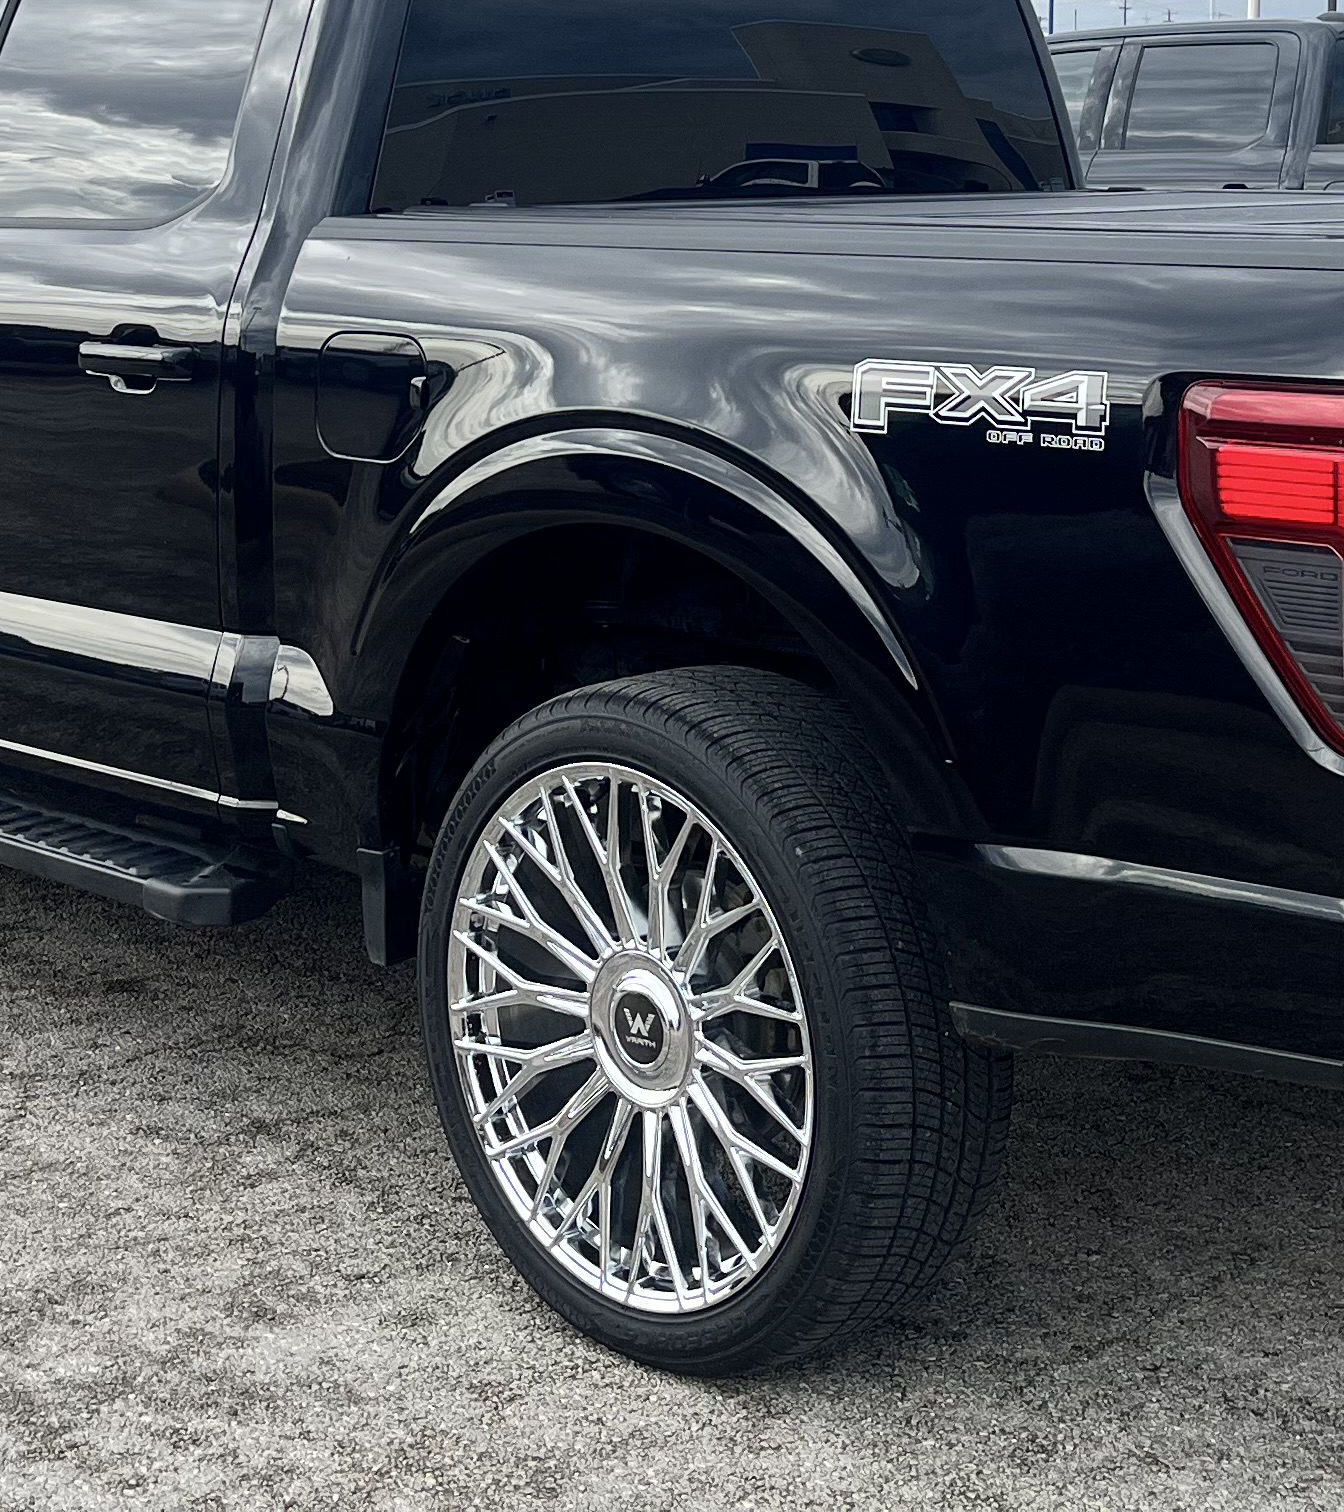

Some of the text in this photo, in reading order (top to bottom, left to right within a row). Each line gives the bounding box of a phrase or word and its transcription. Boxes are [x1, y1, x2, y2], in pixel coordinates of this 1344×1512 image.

[850, 358, 1109, 436] FX4
[987, 430, 1104, 451] OFF ROAD
[1263, 566, 1338, 581] FORD
